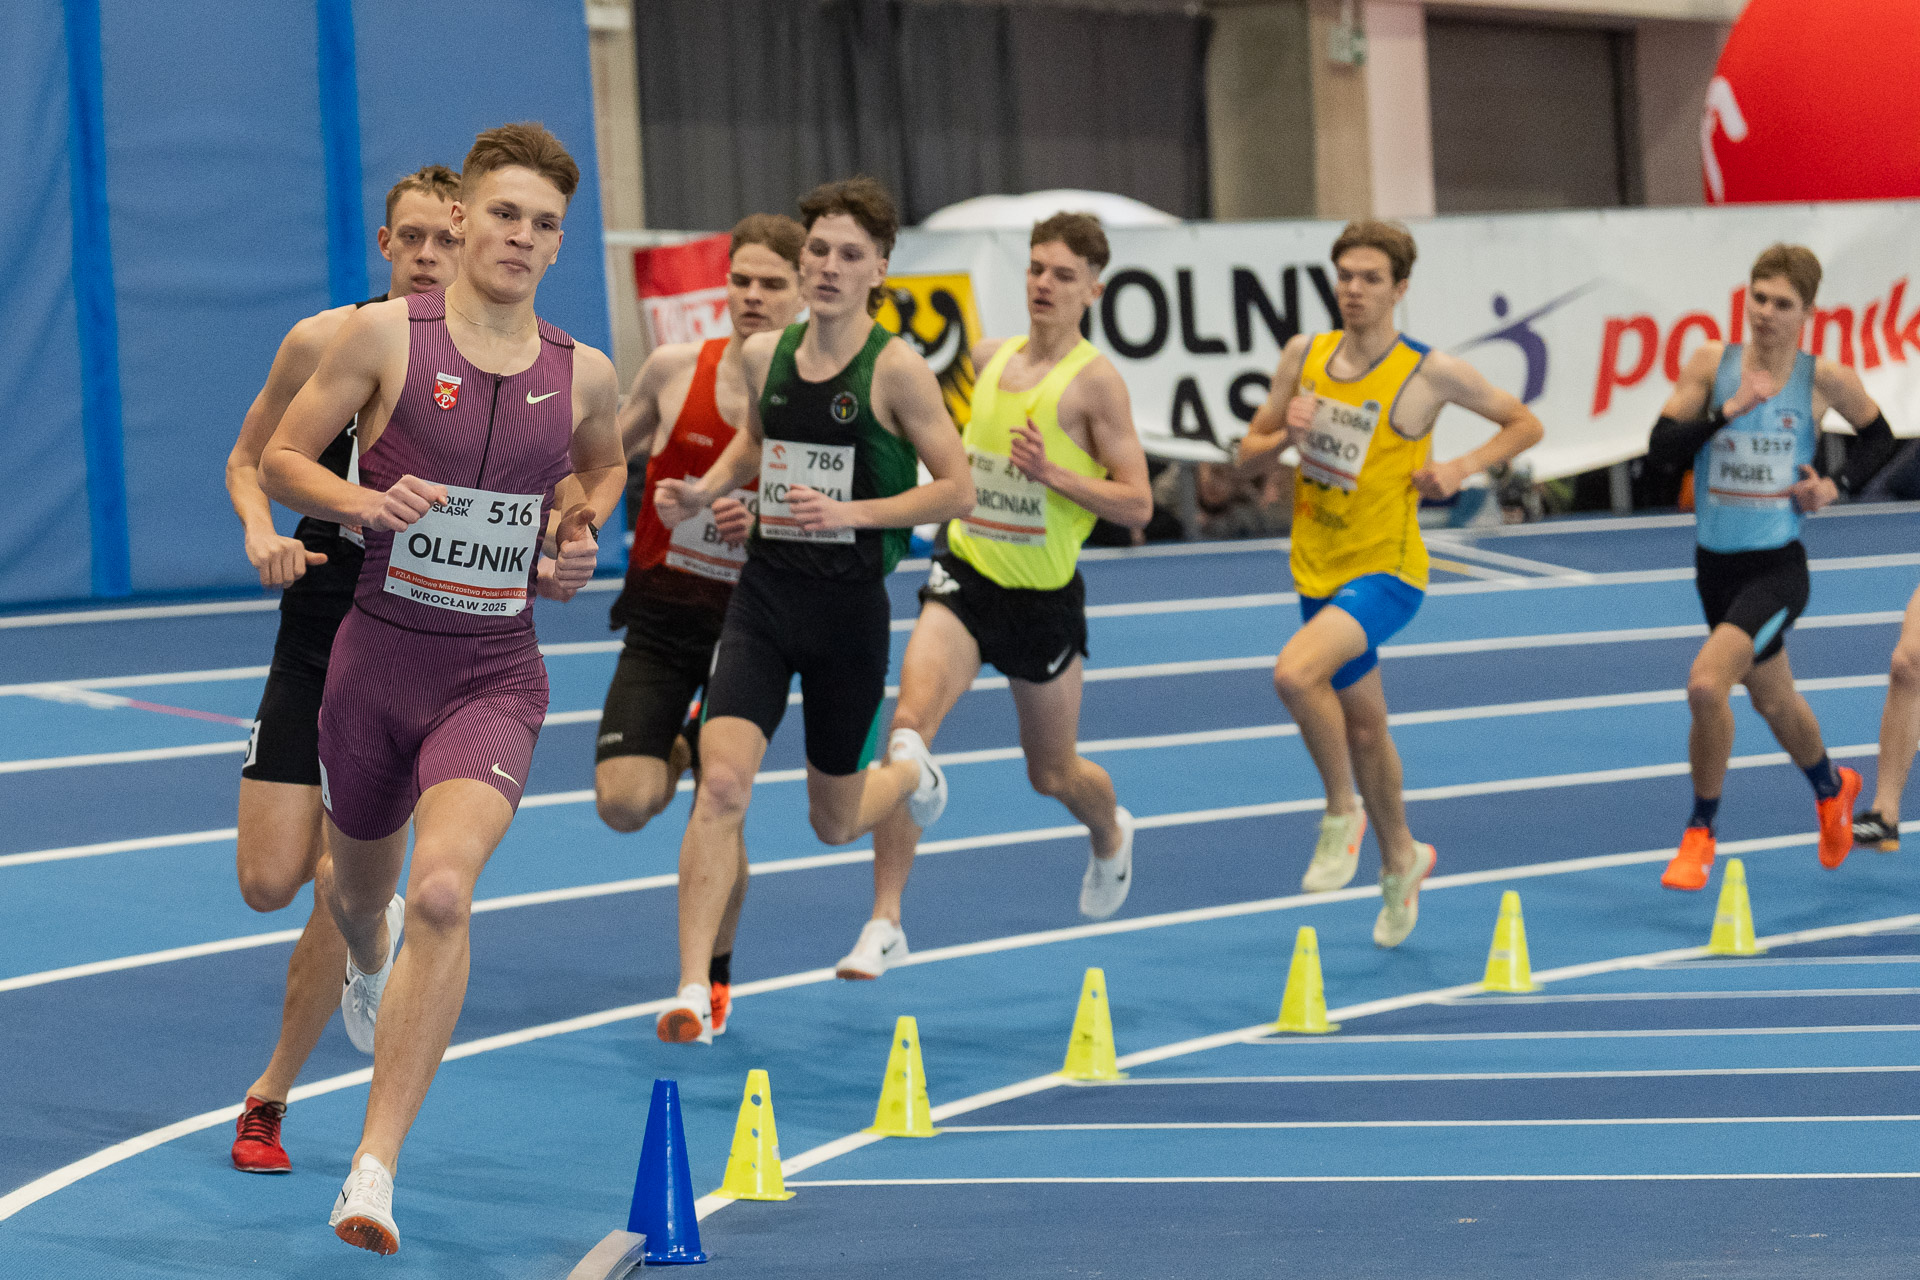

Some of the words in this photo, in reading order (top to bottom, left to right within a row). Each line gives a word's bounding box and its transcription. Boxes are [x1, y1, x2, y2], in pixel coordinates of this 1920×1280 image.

[1080, 266, 1344, 359] OLN
[1589, 276, 1920, 418] polnik
[806, 450, 845, 472] 786
[446, 495, 474, 508] OLNY
[487, 500, 533, 526] 516
[408, 532, 529, 573] OLEJNIK
[395, 570, 411, 580] PZLA
[412, 575, 438, 588] Halowe
[438, 583, 480, 597] Mistrzostwa
[513, 589, 527, 597] U20
[410, 587, 479, 611] WROCŁAW
[481, 602, 507, 612] 2025
